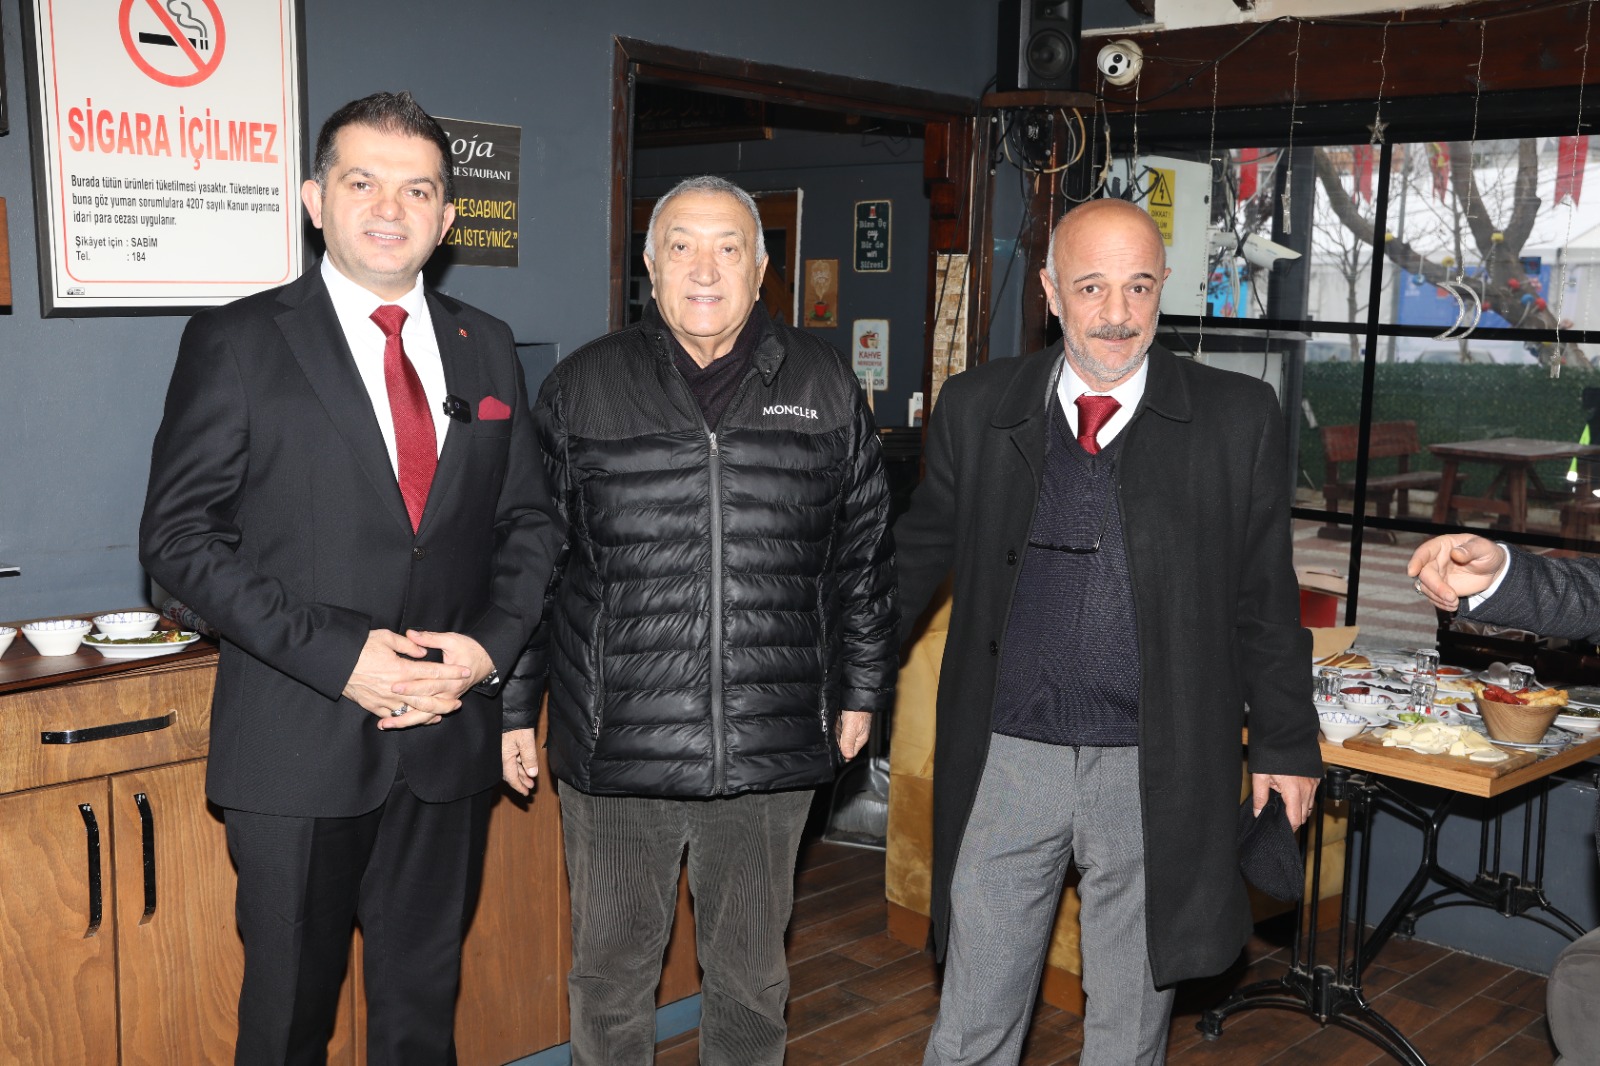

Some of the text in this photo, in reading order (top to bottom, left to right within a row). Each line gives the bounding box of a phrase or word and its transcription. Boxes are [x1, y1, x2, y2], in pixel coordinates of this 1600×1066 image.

[68, 97, 279, 170] SİGARA İÇİLMEZ
[444, 132, 495, 164] oja
[71, 174, 279, 196] Burada tütün ürünleri tüketilmesi yasaktır. Tüketenlere ve
[72, 193, 280, 214] buna göz yuman sorumlulara 4207 sayılı Kanun uyarınca
[73, 210, 177, 227] idari para cezası uygulanır.
[75, 235, 107, 249] Şikâyet
[108, 236, 123, 249] için
[130, 236, 158, 248] SABİM
[75, 250, 91, 261] Tel.
[131, 251, 146, 262] 184
[858, 351, 882, 359] KAHVE
[762, 405, 819, 420] MONCLER
